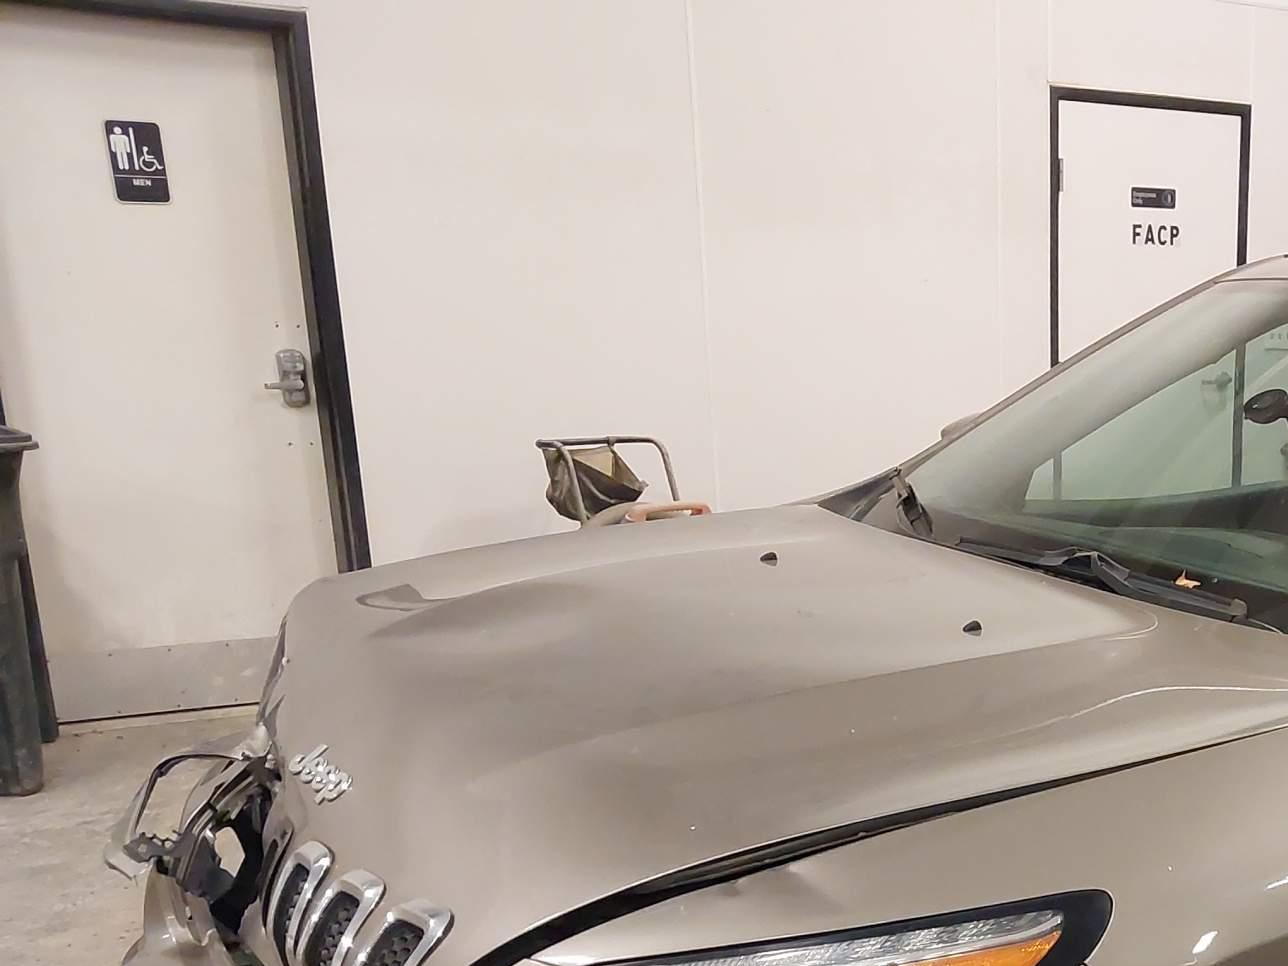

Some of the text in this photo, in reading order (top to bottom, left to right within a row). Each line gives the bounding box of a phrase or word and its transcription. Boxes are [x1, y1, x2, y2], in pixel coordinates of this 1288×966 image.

[132, 178, 152, 187] MEN
[1132, 224, 1180, 246] FACP
[288, 743, 353, 806] Jeep
